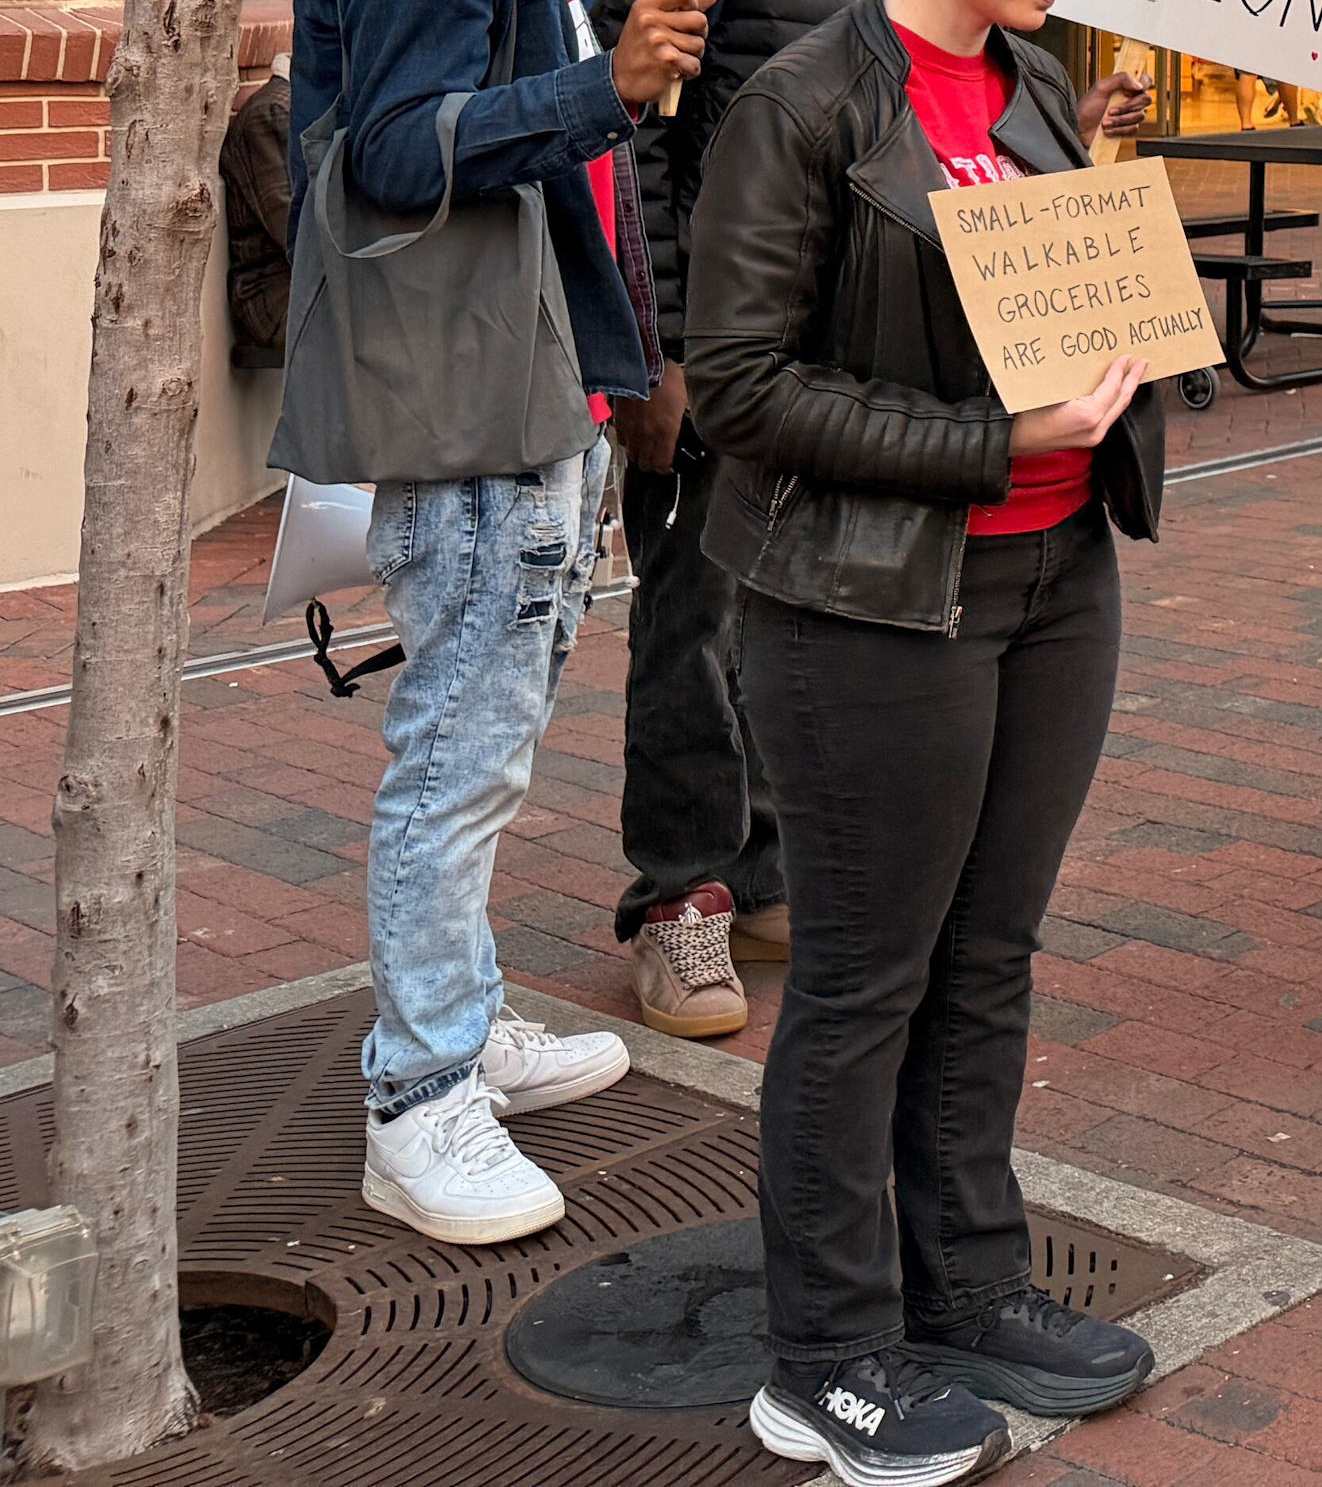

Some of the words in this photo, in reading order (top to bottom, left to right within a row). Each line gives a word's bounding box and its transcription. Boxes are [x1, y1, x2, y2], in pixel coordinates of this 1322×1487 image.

[957, 185, 1150, 233] SMALL-FORMAT
[972, 226, 1144, 281] WALKABLE
[997, 274, 1151, 323] GROCERIES
[1002, 337, 1045, 370] ARE
[1060, 327, 1117, 357] GOOD
[1128, 307, 1204, 345] ACTUALLY
[818, 1387, 885, 1436] HOKA
